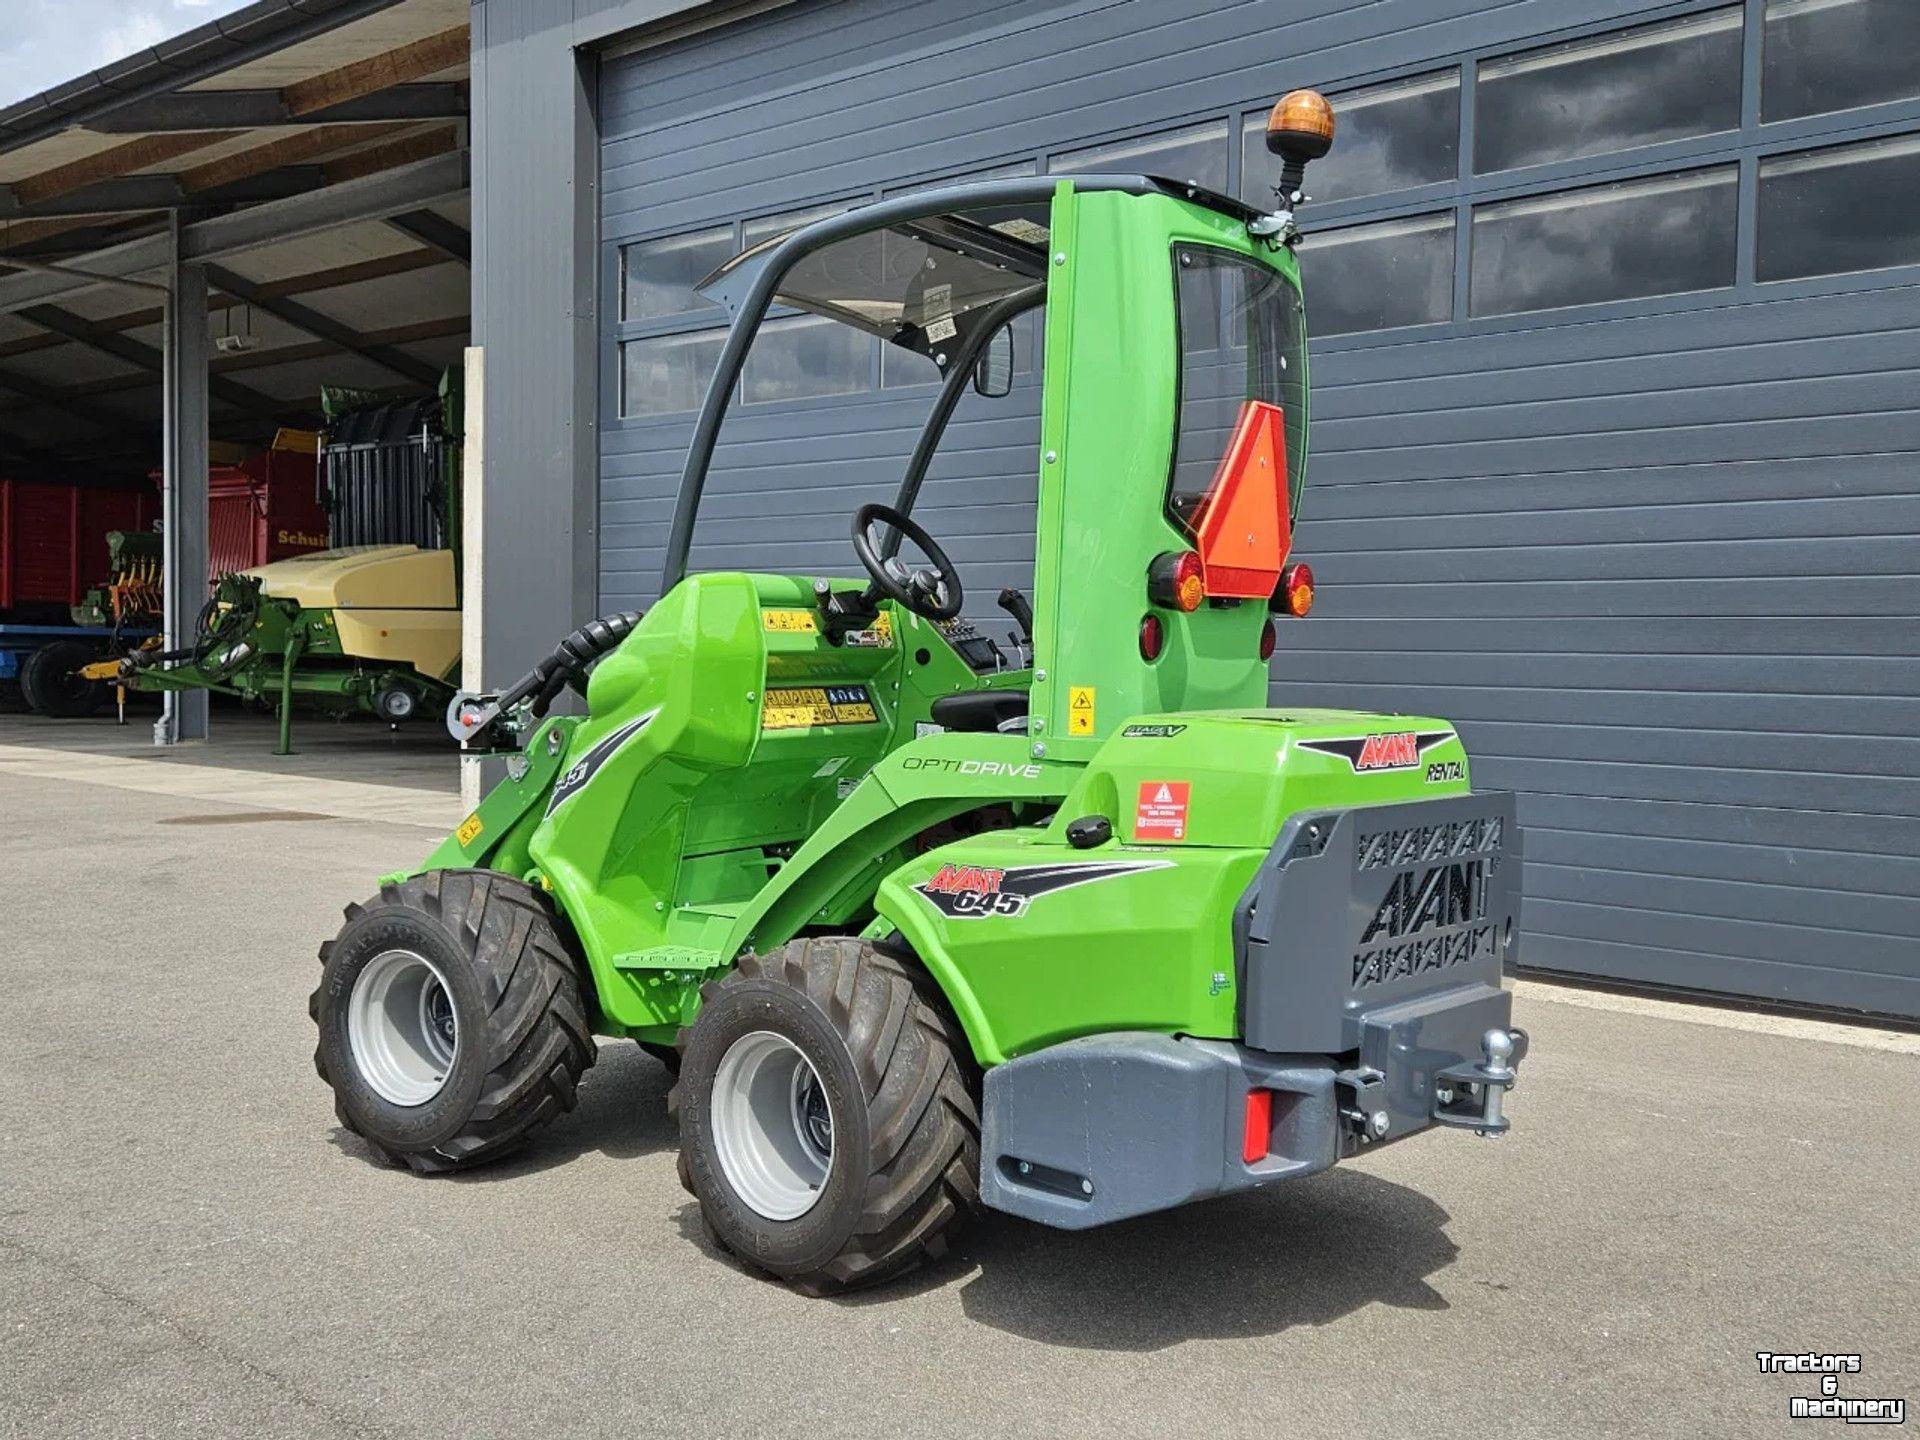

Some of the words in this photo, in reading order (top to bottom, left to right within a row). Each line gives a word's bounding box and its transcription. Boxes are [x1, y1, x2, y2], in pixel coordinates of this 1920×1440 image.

[1356, 731, 1419, 770] AVANT
[903, 757, 1042, 779] OPTIDRIVE
[1425, 761, 1465, 783] RENTAL
[923, 863, 1006, 896] AVANT
[953, 889, 1027, 918] 645
[1360, 857, 1494, 944] AVANT
